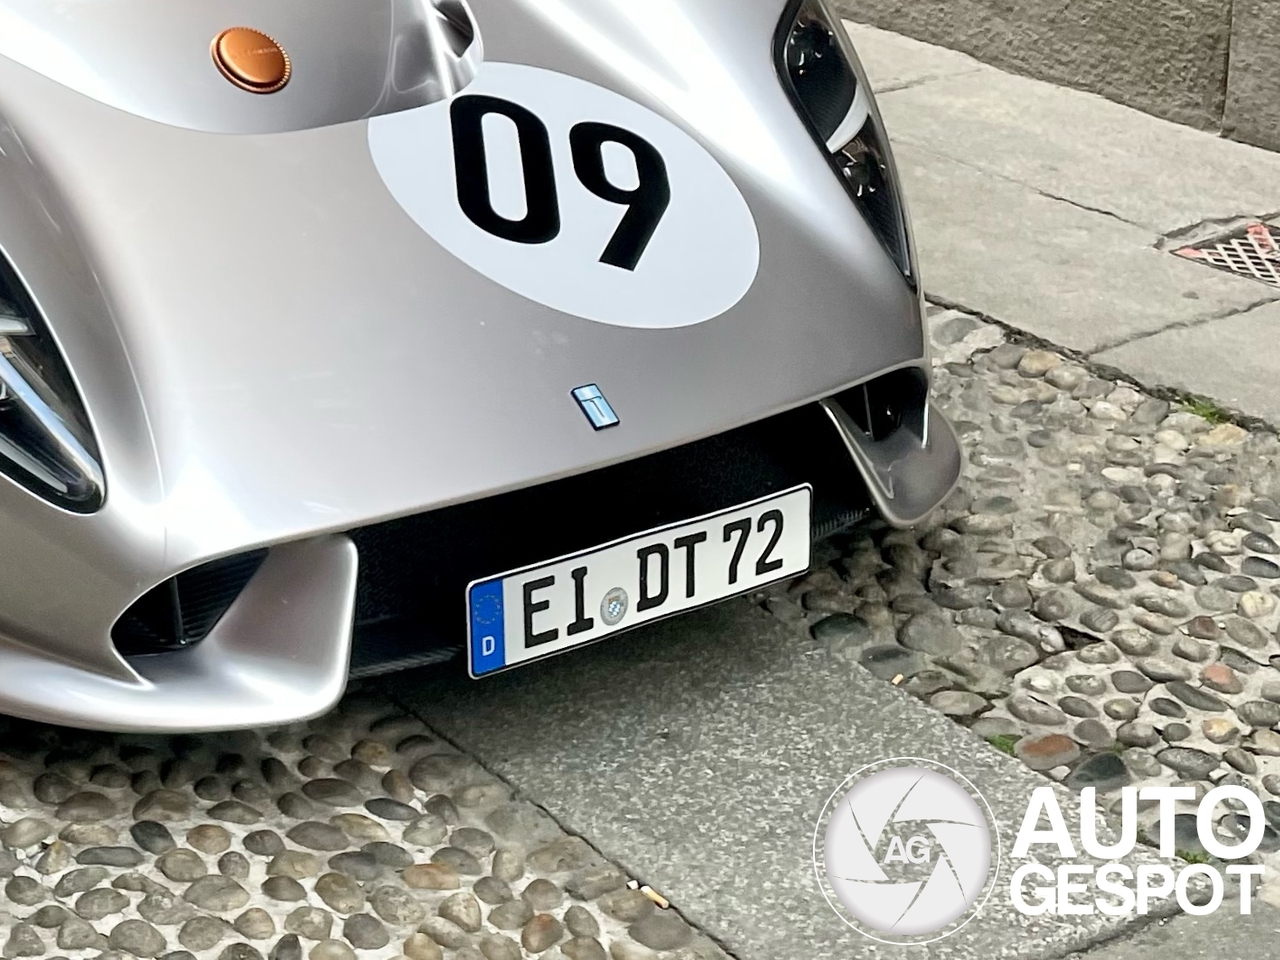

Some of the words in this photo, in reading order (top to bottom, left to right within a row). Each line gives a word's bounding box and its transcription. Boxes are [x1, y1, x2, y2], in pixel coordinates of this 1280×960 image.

[449, 94, 671, 272] 09
[481, 635, 496, 657] D
[522, 566, 595, 649] EI
[636, 531, 707, 613] DT
[722, 509, 784, 585] 72
